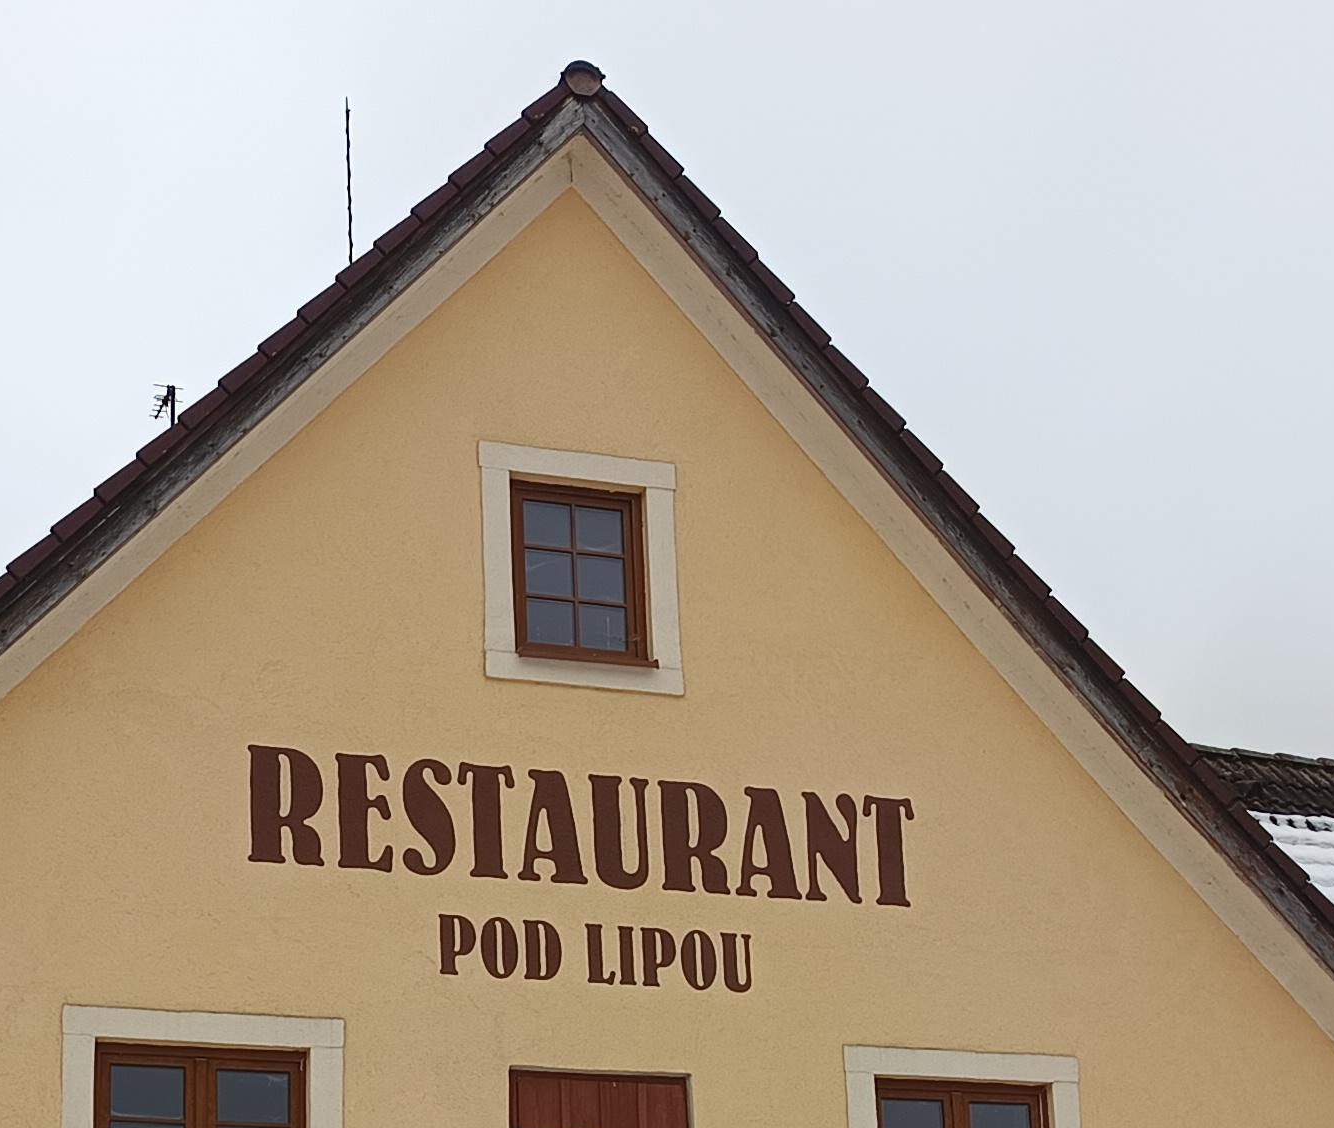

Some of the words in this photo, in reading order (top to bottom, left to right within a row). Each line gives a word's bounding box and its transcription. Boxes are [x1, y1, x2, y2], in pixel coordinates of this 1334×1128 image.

[248, 744, 914, 907] RESTAURANT
[438, 913, 563, 981] POD
[585, 922, 752, 993] LIPOU
